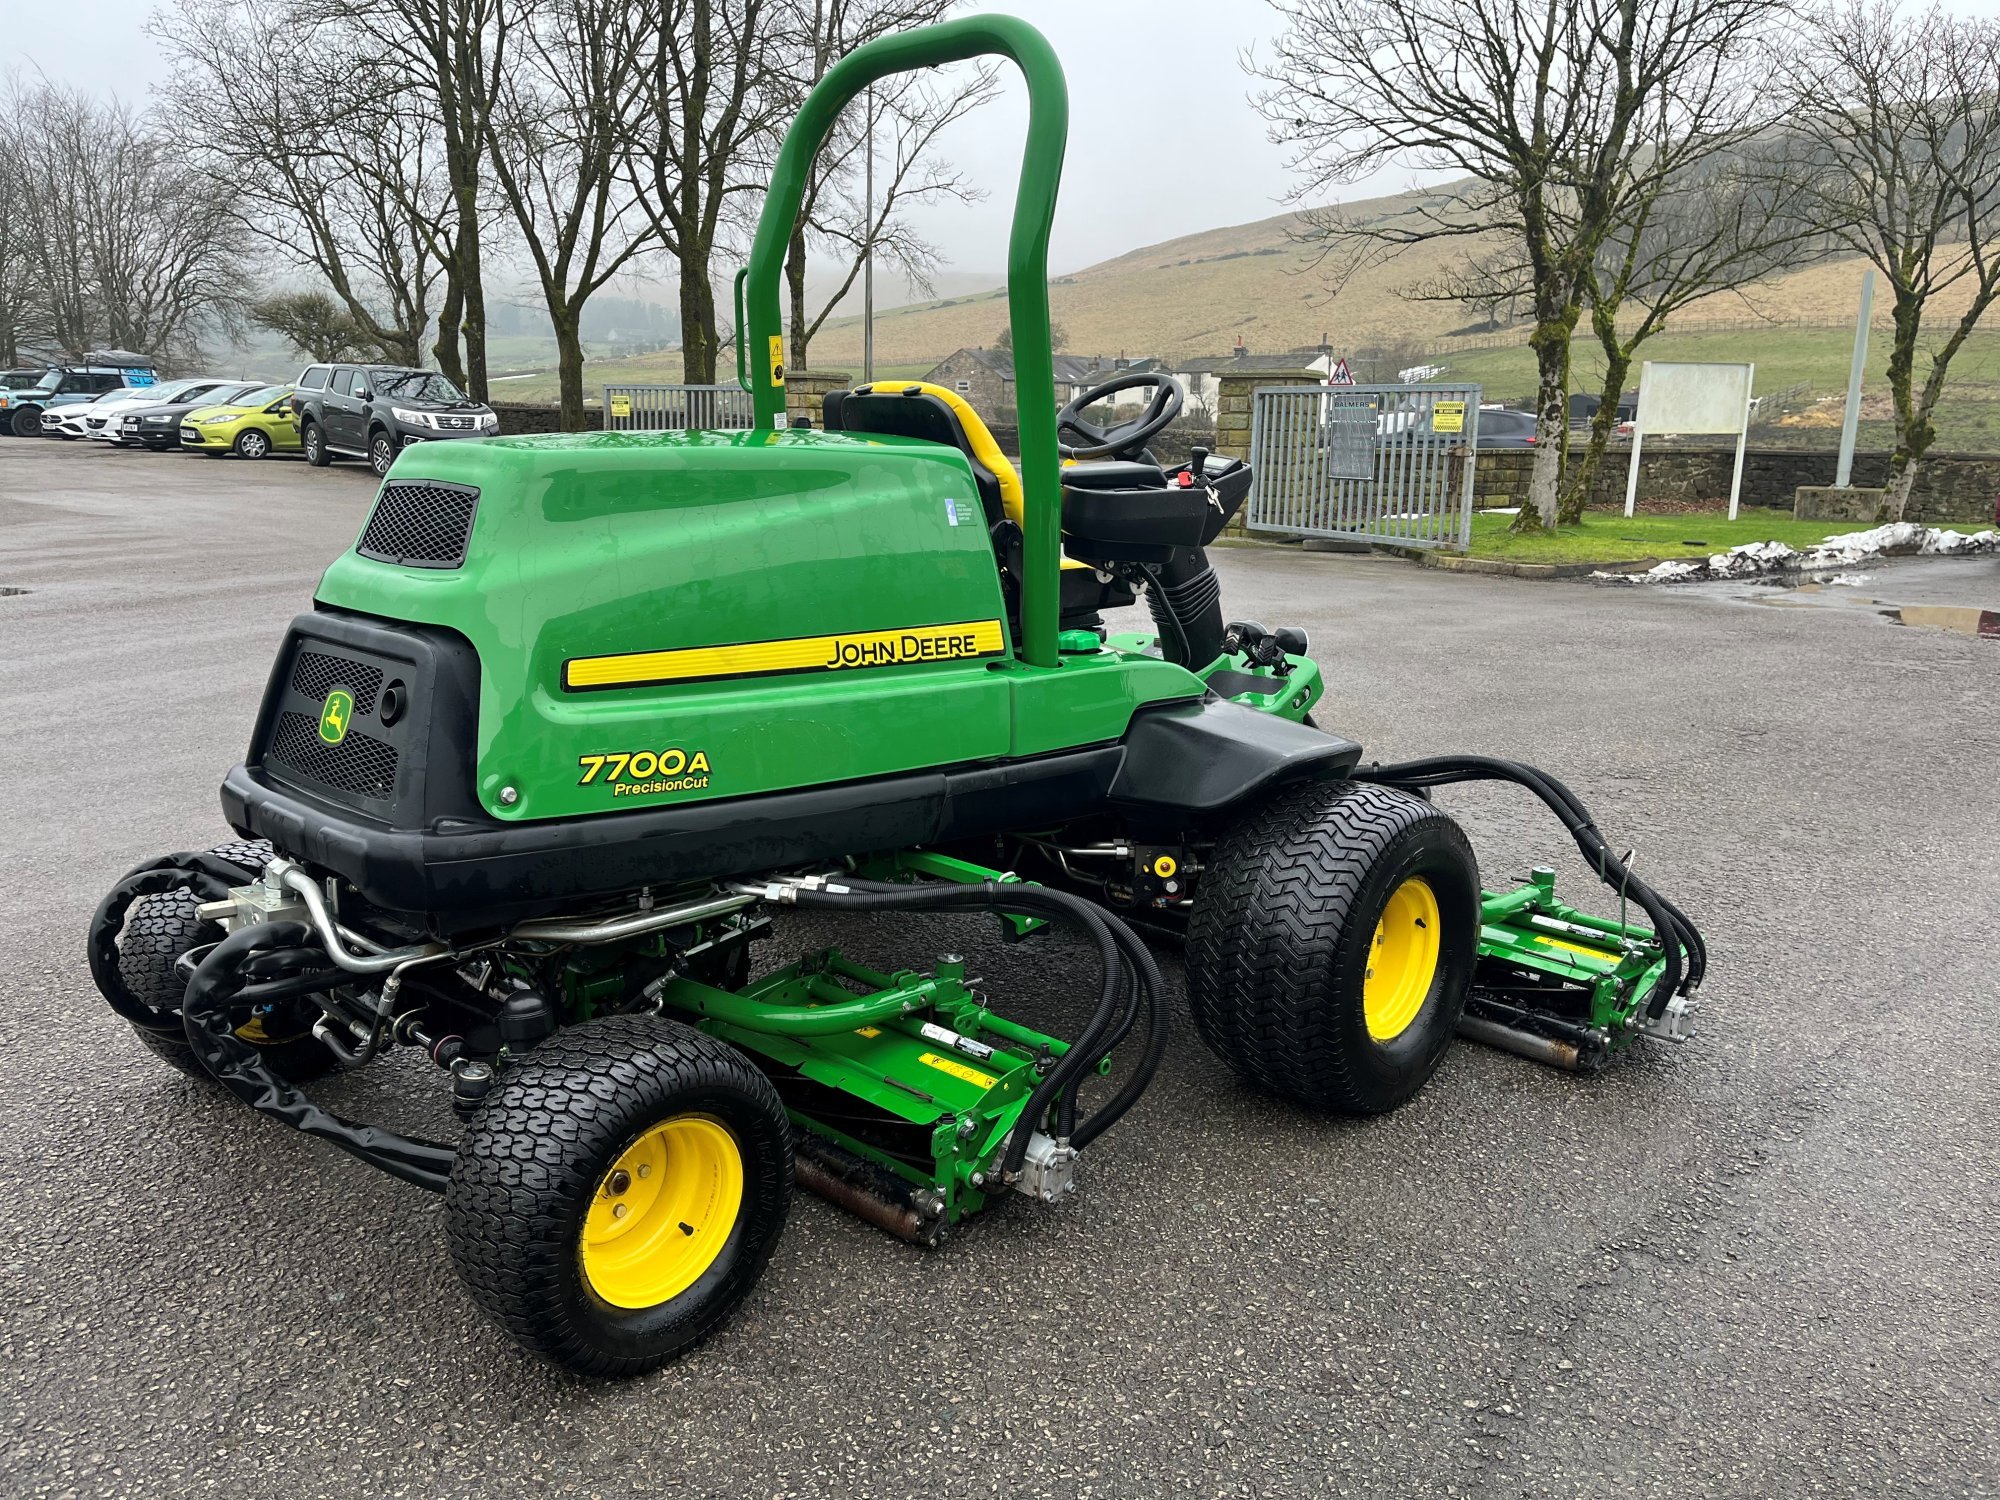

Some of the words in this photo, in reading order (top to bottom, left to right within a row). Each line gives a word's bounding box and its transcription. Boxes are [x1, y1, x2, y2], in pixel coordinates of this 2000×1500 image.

[827, 640, 895, 665] JOHN
[901, 634, 977, 659] DEERE
[579, 748, 711, 784] 7700A
[614, 776, 709, 797] PrecisionCut
